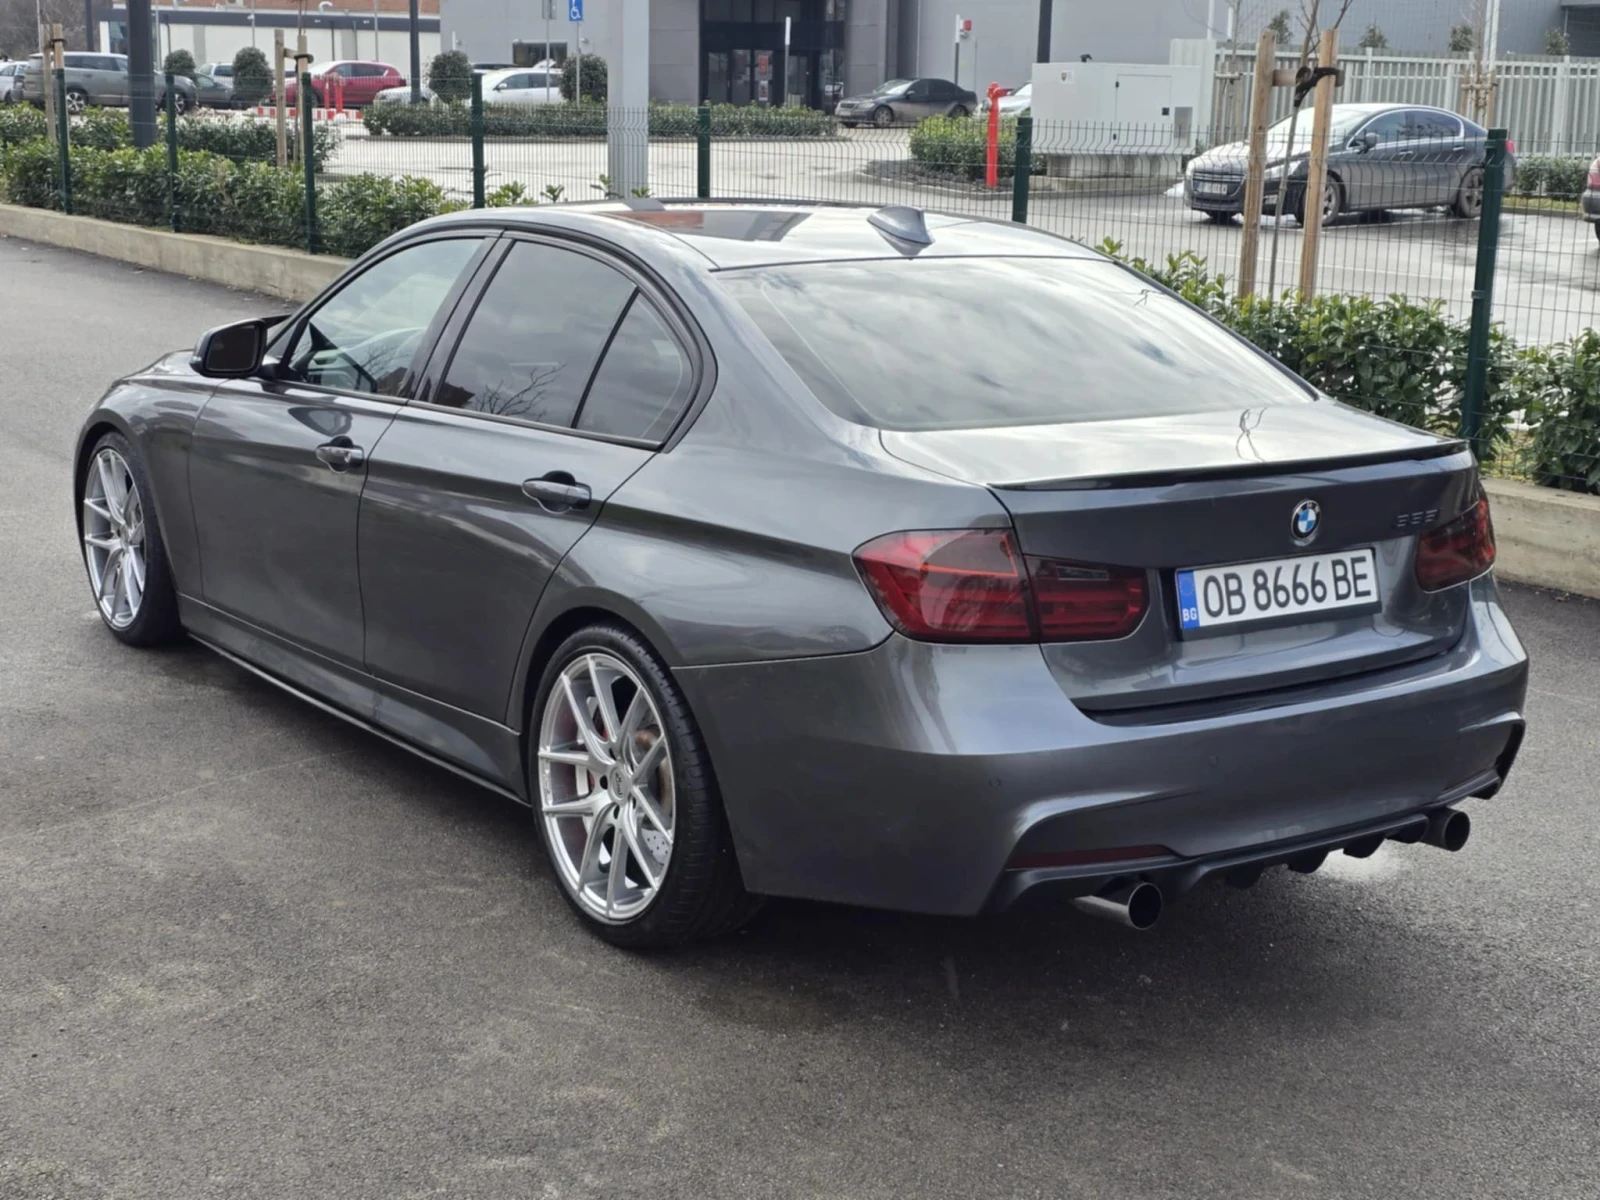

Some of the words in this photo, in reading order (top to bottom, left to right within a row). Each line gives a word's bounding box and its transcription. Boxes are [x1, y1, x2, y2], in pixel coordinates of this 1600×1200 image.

[1203, 572, 1246, 618] OB
[1253, 561, 1327, 612] 8666
[1331, 556, 1372, 601] BE
[1181, 608, 1197, 622] BG
